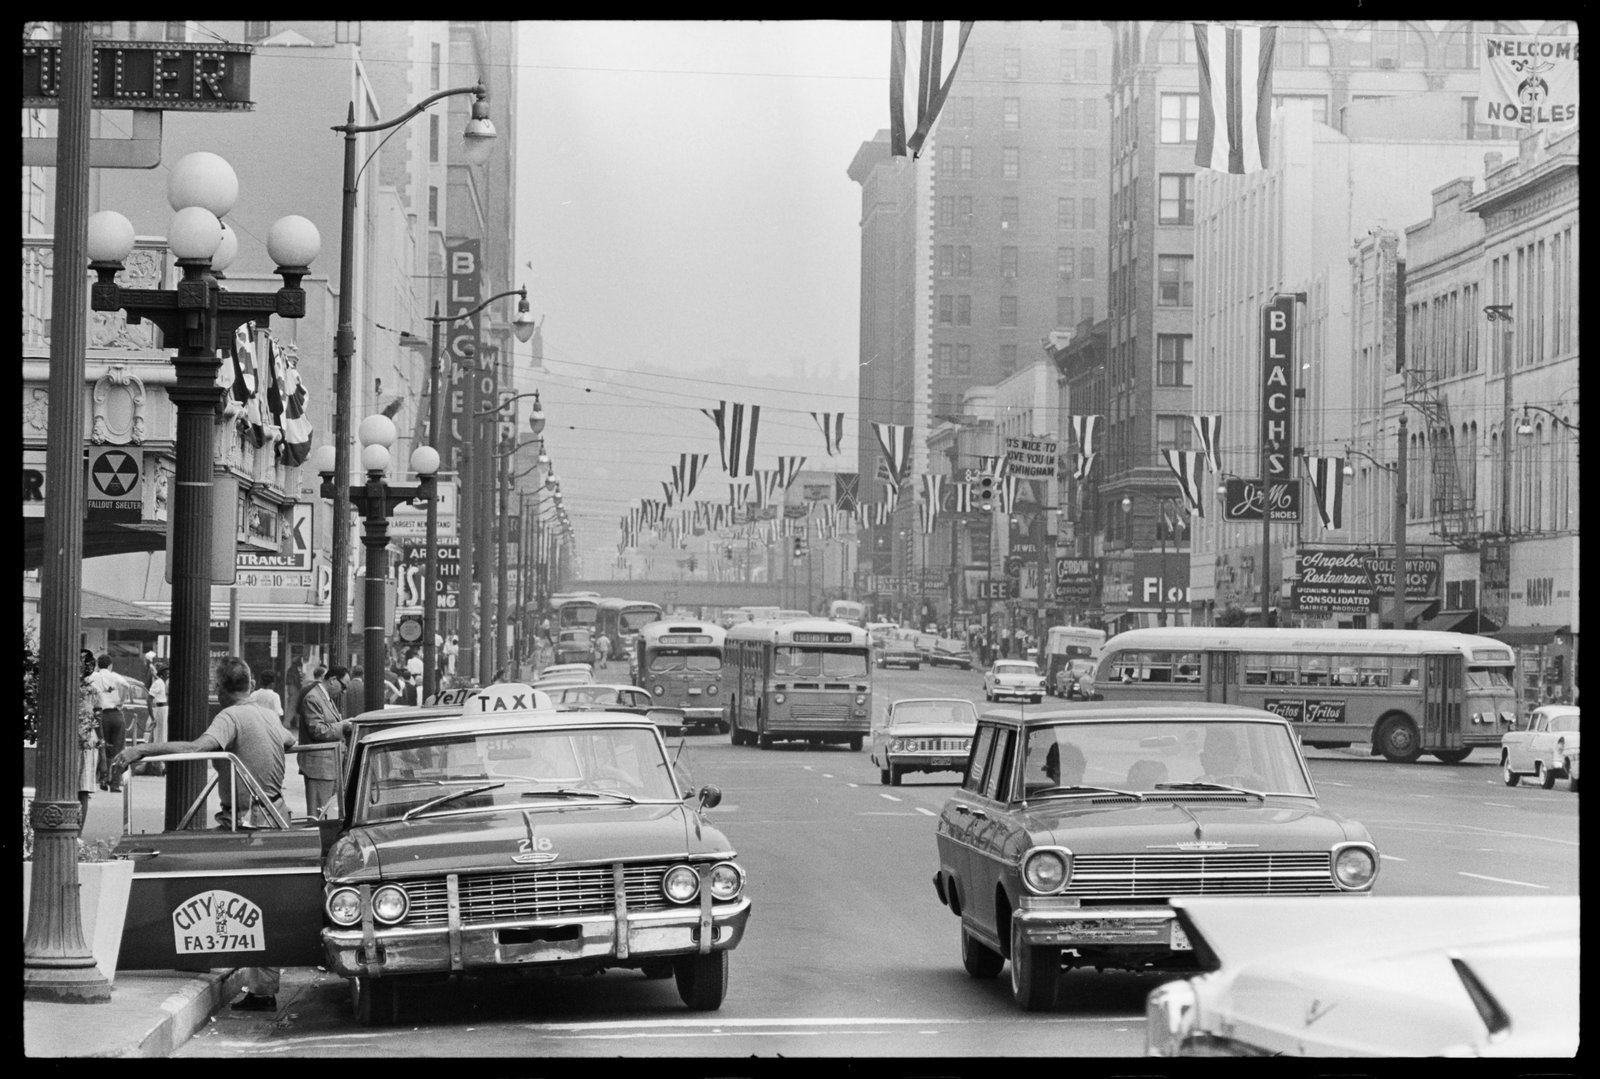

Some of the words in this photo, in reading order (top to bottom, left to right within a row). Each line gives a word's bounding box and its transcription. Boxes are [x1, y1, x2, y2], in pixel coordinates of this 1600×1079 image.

[1487, 102, 1576, 123] NOBLES
[1021, 440, 1041, 452] NICE
[1044, 442, 1057, 452] TO
[1027, 453, 1044, 464] YOU
[1046, 455, 1055, 465] IN
[88, 501, 113, 509] FALLOUT
[115, 502, 141, 510] SHELTER
[1270, 511, 1297, 519] SHOES
[1374, 573, 1429, 586] STUIOS
[1300, 595, 1370, 606] CONSOLIDATED
[478, 692, 537, 712] TAXI
[1306, 704, 1341, 723] Fritos
[174, 896, 213, 930] CITY
[226, 898, 260, 929] CAB
[184, 935, 203, 951] FA
